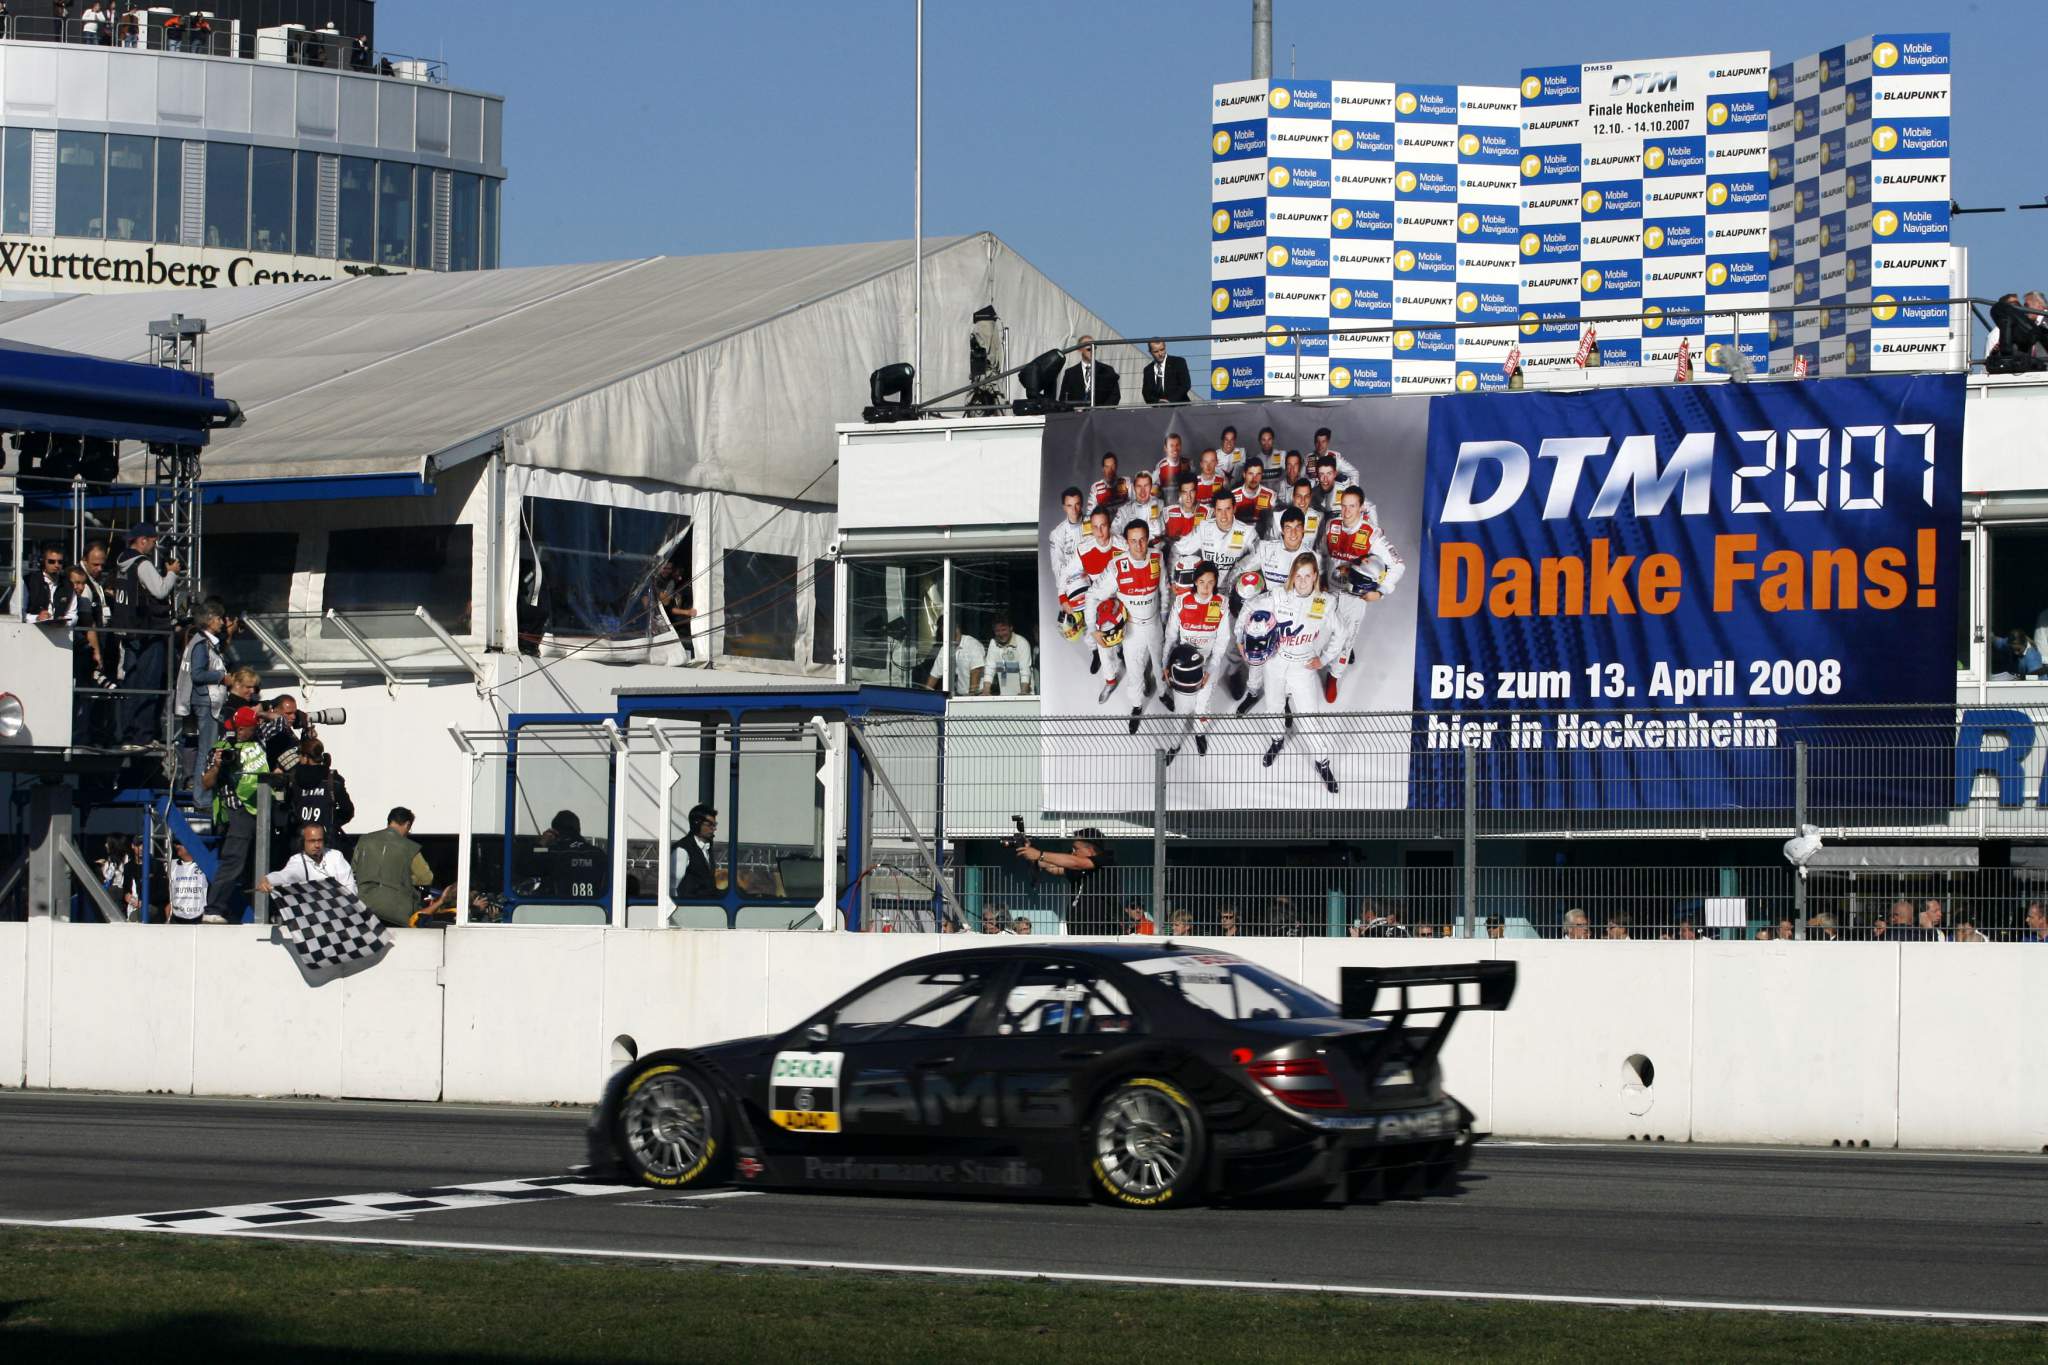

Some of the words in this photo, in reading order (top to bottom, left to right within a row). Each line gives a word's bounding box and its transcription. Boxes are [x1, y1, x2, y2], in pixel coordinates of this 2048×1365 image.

[1904, 44, 1932, 53] Mobile
[1904, 56, 1947, 66] Navigation
[1716, 67, 1767, 77] BLAUPUNKT
[1545, 76, 1567, 85] Mobile
[1609, 71, 1678, 96] DTM
[1294, 90, 1317, 98] Mobile
[1545, 87, 1579, 96] Navigation
[1884, 91, 1947, 100] BLAUPUNKT
[1221, 94, 1265, 106] BLAUPUNKT
[1294, 100, 1330, 109] Navigation
[1420, 105, 1456, 114] Navigation
[1589, 104, 1622, 117] Finale
[1626, 100, 1695, 115] Hockenheim
[1732, 103, 1754, 111] Mobile
[1731, 114, 1766, 123] Navigation
[1530, 120, 1579, 130] BLAUPUNKT
[1593, 123, 1624, 135] 12.10.
[1634, 119, 1690, 133] 14.10.2007
[1235, 130, 1254, 139] Mobile
[1357, 132, 1380, 140] Mobile
[1903, 128, 1931, 136] Mobile
[1235, 141, 1265, 150] Navigation
[1357, 142, 1393, 151] Navigation
[1404, 139, 1454, 147] BLAUPUNKT
[1903, 139, 1947, 150] Navigation
[1483, 146, 1518, 156] Navigation
[1668, 147, 1691, 155] Mobile
[1716, 147, 1767, 157] BLAUPUNKT
[1544, 155, 1566, 163] Mobile
[1591, 155, 1640, 165] BLAUPUNKT
[1668, 158, 1703, 167] Navigation
[1293, 169, 1316, 177] Mobile
[1544, 166, 1579, 175] Navigation
[1221, 173, 1265, 184] BLAUPUNKT
[1420, 173, 1443, 181] Mobile
[1883, 175, 1946, 184] BLAUPUNKT
[1293, 178, 1329, 188] Navigation
[1731, 183, 1754, 191] Mobile
[1420, 183, 1456, 193] Navigation
[1606, 191, 1628, 199] Mobile
[1653, 191, 1704, 201] BLAUPUNKT
[1731, 194, 1766, 203] Navigation
[1529, 199, 1579, 208] BLAUPUNKT
[1606, 202, 1640, 211] Navigation
[1234, 208, 1253, 218] Mobile
[1277, 213, 1328, 221] BLAUPUNKT
[1356, 211, 1379, 219] Mobile
[1904, 212, 1931, 221] Mobile
[1483, 215, 1505, 223] Mobile
[1234, 220, 1264, 230] Navigation
[1356, 220, 1392, 230] Navigation
[1482, 225, 1518, 234] Navigation
[1904, 224, 1947, 234] Navigation
[1668, 227, 1690, 235] Mobile
[1716, 228, 1767, 237] BLAUPUNKT
[1544, 234, 1566, 242] Mobile
[1590, 235, 1640, 244] BLAUPUNKT
[1668, 238, 1703, 247] Navigation
[1292, 248, 1315, 256] Mobile
[1544, 245, 1578, 253] Navigation
[1220, 252, 1264, 263] BLAUPUNKT
[1419, 253, 1441, 261] Mobile
[1292, 258, 1328, 267] Navigation
[1419, 262, 1455, 272] Navigation
[1465, 259, 1516, 267] BLAUPUNKT
[1883, 260, 1947, 268] BLAUPUNKT
[1731, 264, 1753, 272] Mobile
[1605, 270, 1627, 278] Mobile
[1652, 271, 1703, 280] BLAUPUNKT
[1529, 278, 1578, 287] BLAUPUNKT
[1731, 274, 1766, 284] Navigation
[1605, 281, 1640, 290] Navigation
[1233, 288, 1253, 296] Mobile
[1275, 291, 1327, 300] BLAUPUNKT
[1355, 290, 1378, 298] Mobile
[1481, 294, 1504, 302] Mobile
[1234, 299, 1264, 308] Navigation
[1355, 299, 1391, 308] Navigation
[1481, 304, 1517, 313] Navigation
[1903, 308, 1947, 319] Navigation
[1667, 318, 1702, 326] Navigation
[1543, 324, 1578, 333] Navigation
[1418, 331, 1441, 340] Mobile
[1291, 337, 1328, 347] Nvigation
[1418, 341, 1454, 351] Navigation
[1465, 338, 1516, 346] BLAUPUNKT
[1883, 344, 1946, 352] BLAUPUNKT
[1604, 349, 1626, 358] Mobile
[1652, 351, 1703, 361] BLAUPKT
[1233, 367, 1252, 376] Mobile
[1354, 369, 1377, 377] Mobile
[1401, 376, 1453, 384] BLAUPUNKT
[1481, 373, 1503, 381] Mobile
[1234, 378, 1264, 388] Navigation
[1354, 378, 1391, 388] Navigation
[1439, 432, 1716, 523] DTM
[1730, 423, 1936, 514] 2007
[1437, 537, 1683, 619] Danke
[1713, 528, 1937, 613] Fans!
[1430, 664, 1485, 699] Bis
[1497, 669, 1571, 698] zum
[1586, 662, 1636, 698] 13.
[1648, 660, 1735, 705] April
[1749, 658, 1842, 696] 2008
[1427, 713, 1499, 749] hier
[1510, 713, 1543, 749] in
[1556, 711, 1778, 749] Hockenheim
[572, 882, 593, 896] 088
[773, 1059, 834, 1078] DEKRA
[793, 1087, 816, 1111] 6
[804, 1156, 954, 1183] Performance
[961, 1159, 1043, 1185] Studio
